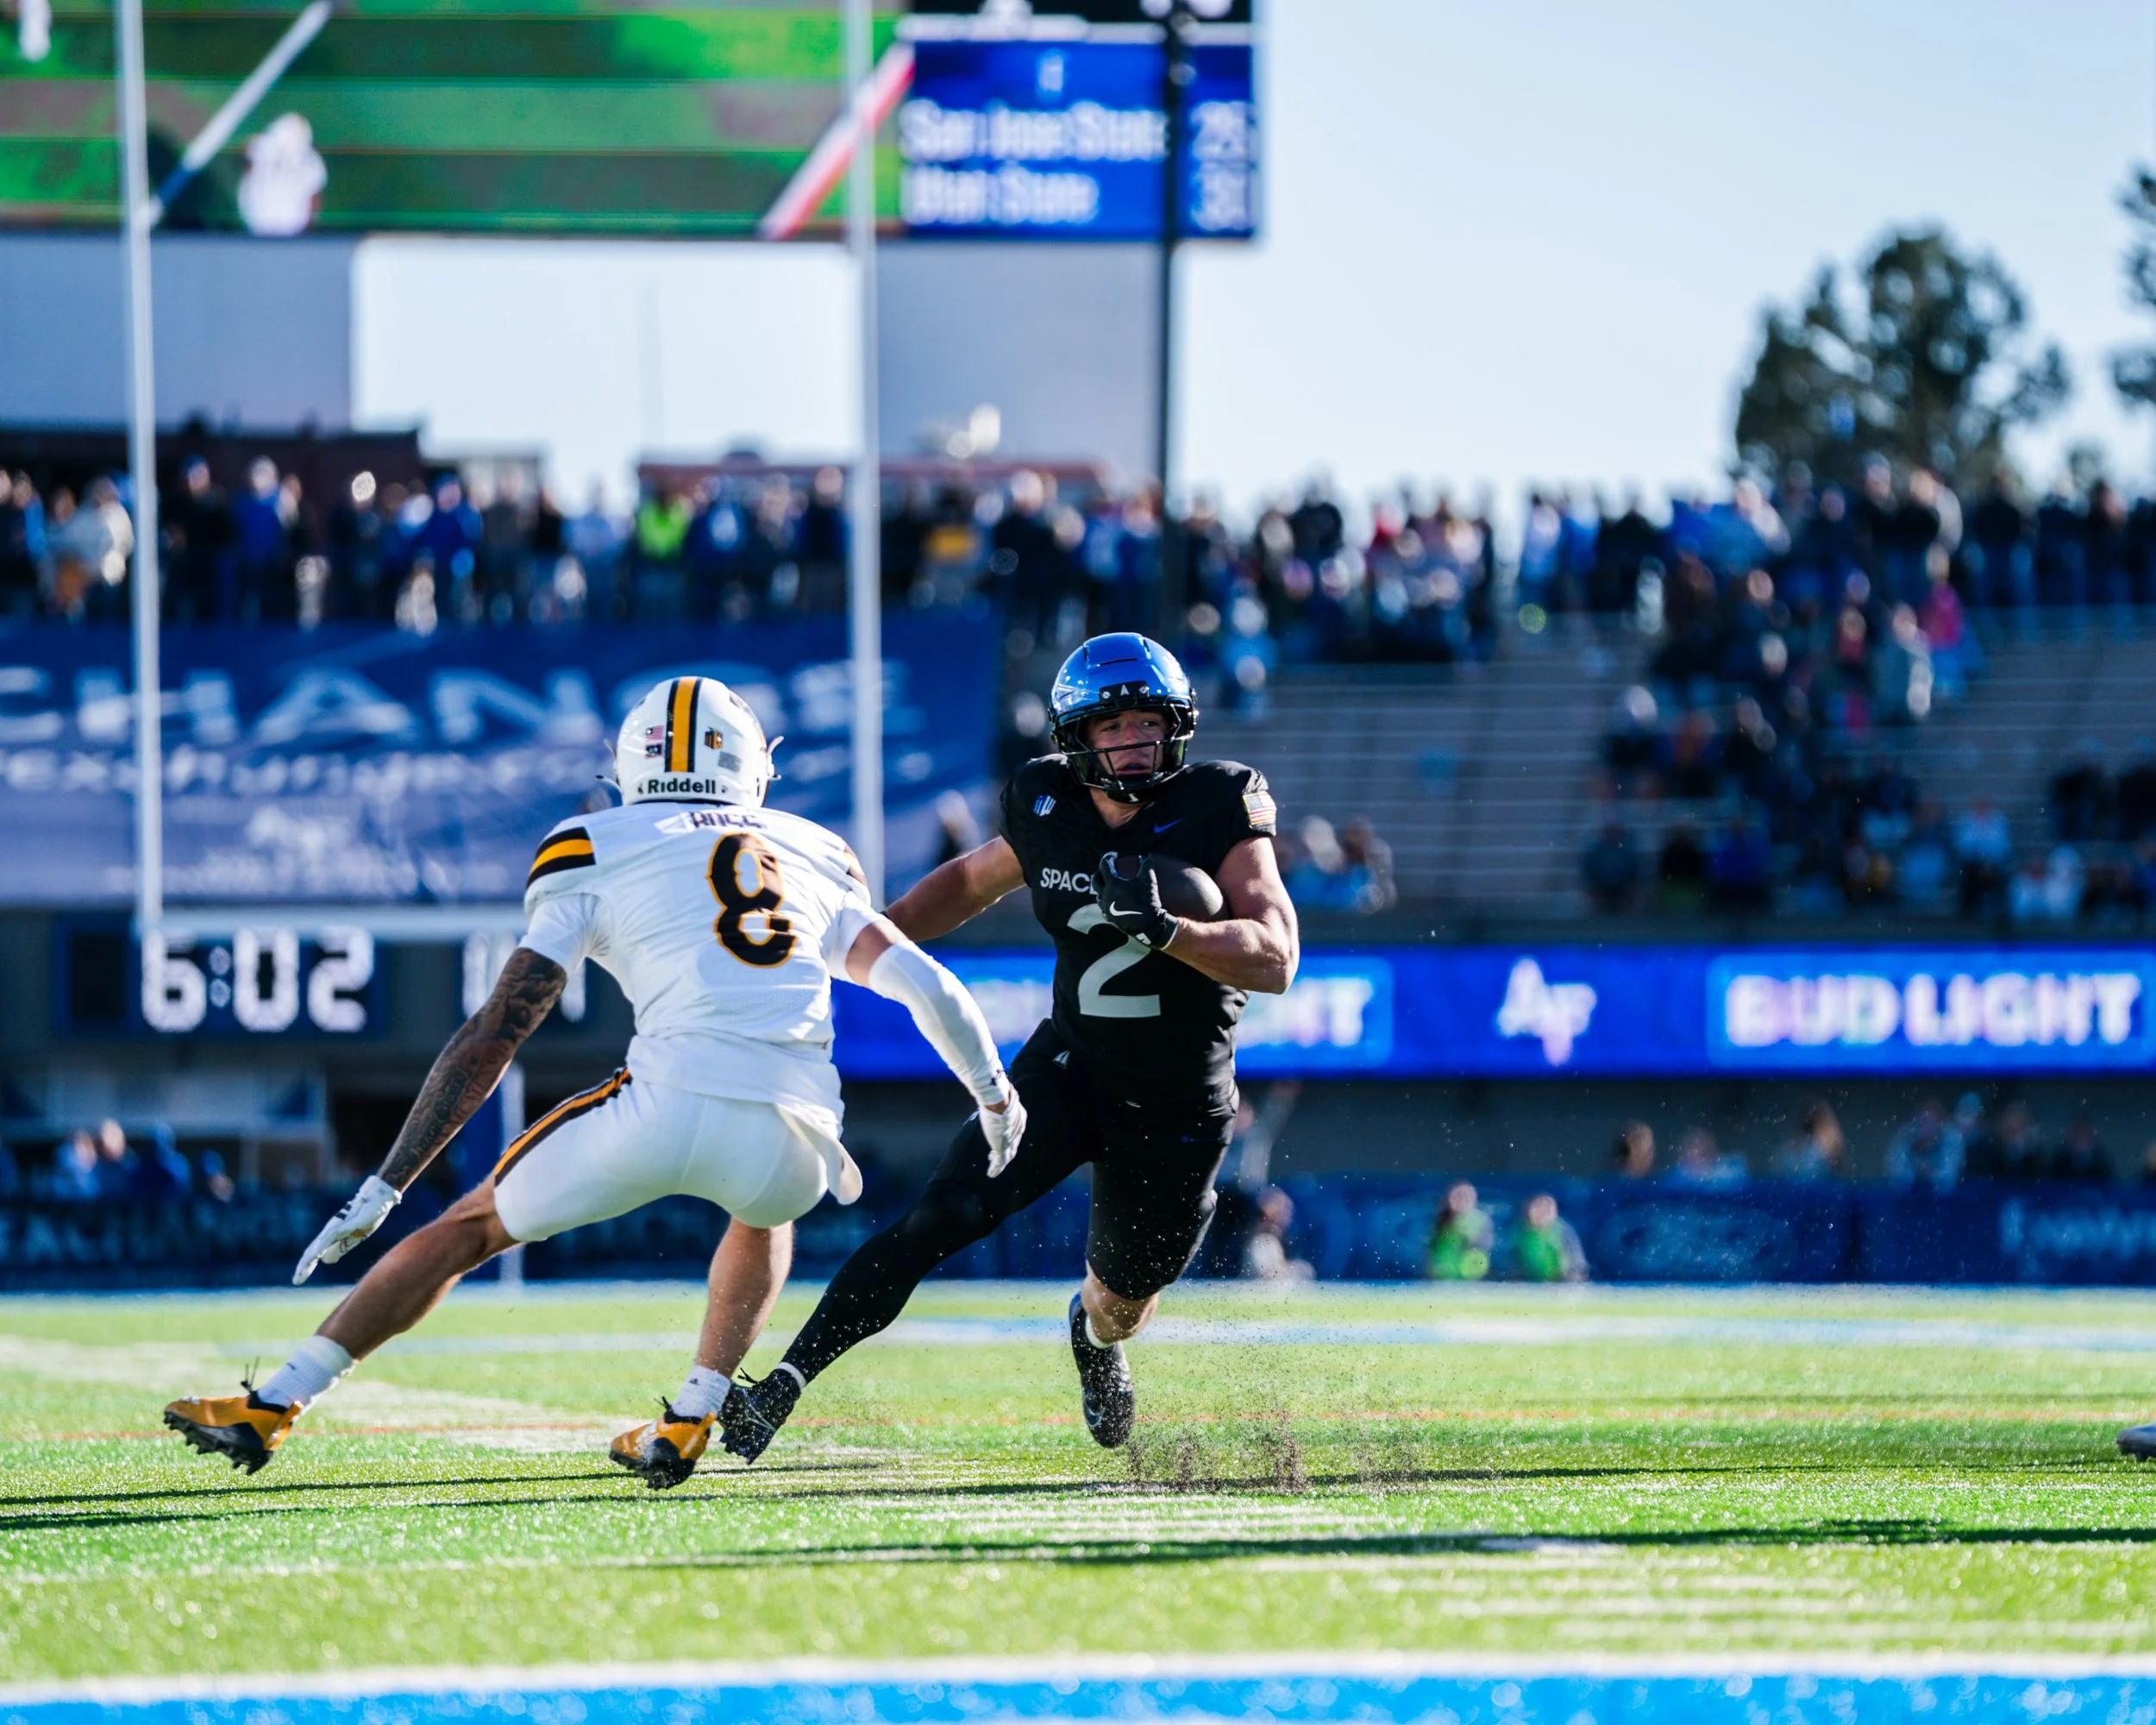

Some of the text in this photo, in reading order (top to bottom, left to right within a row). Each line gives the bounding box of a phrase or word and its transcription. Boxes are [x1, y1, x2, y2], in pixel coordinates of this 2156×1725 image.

[648, 778, 716, 794] Riddell
[705, 832, 799, 969] 8
[141, 927, 374, 1033] 6:02
[1067, 903, 1162, 1018] 2
[1725, 972, 2142, 1047] BUD LIGHT
